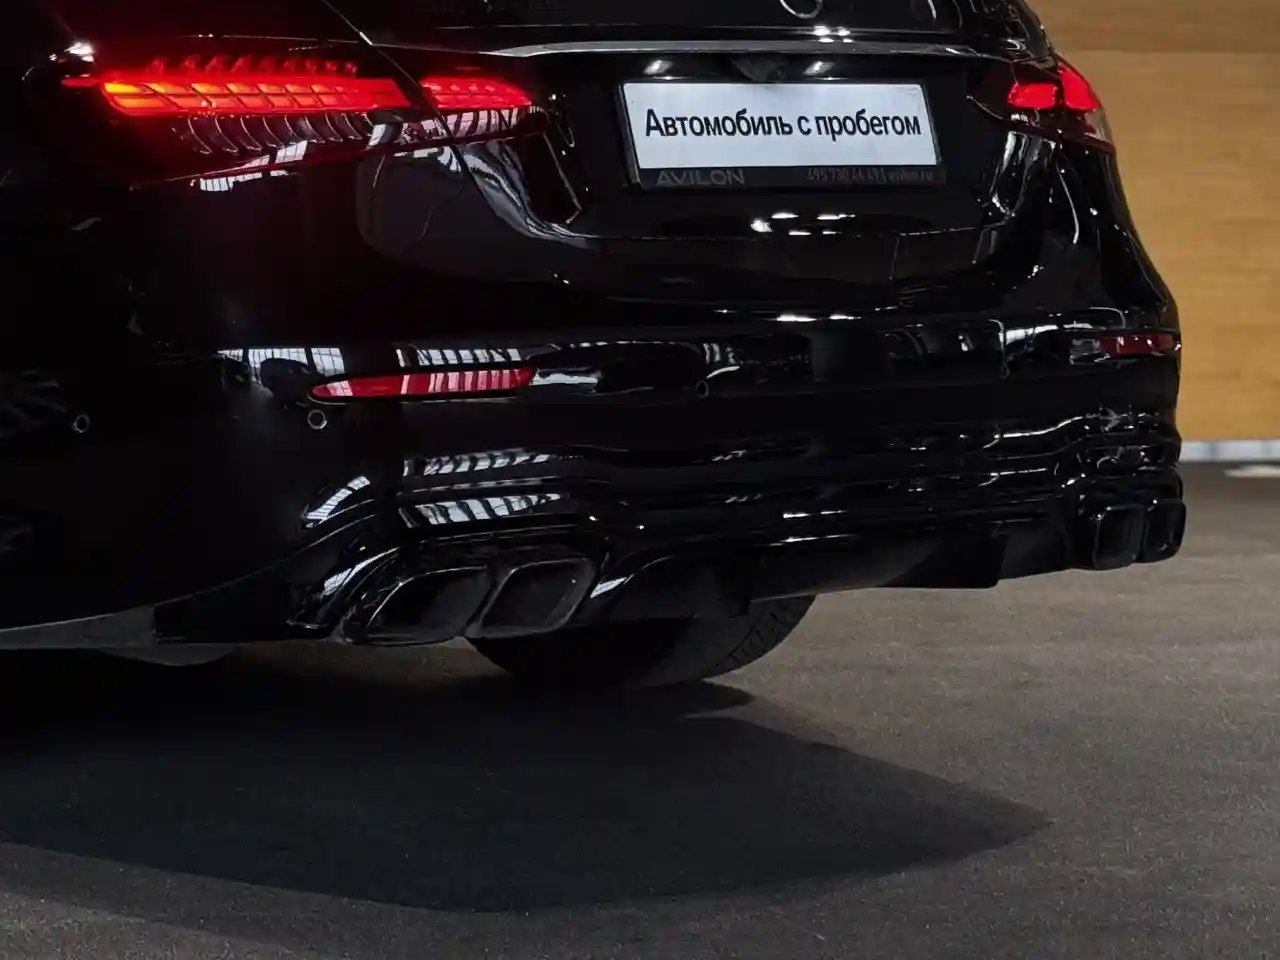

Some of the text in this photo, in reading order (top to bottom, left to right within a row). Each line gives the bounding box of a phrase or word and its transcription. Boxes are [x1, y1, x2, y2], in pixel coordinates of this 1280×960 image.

[645, 108, 922, 141] Автомобиль с пробегом
[657, 169, 746, 186] AVILON
